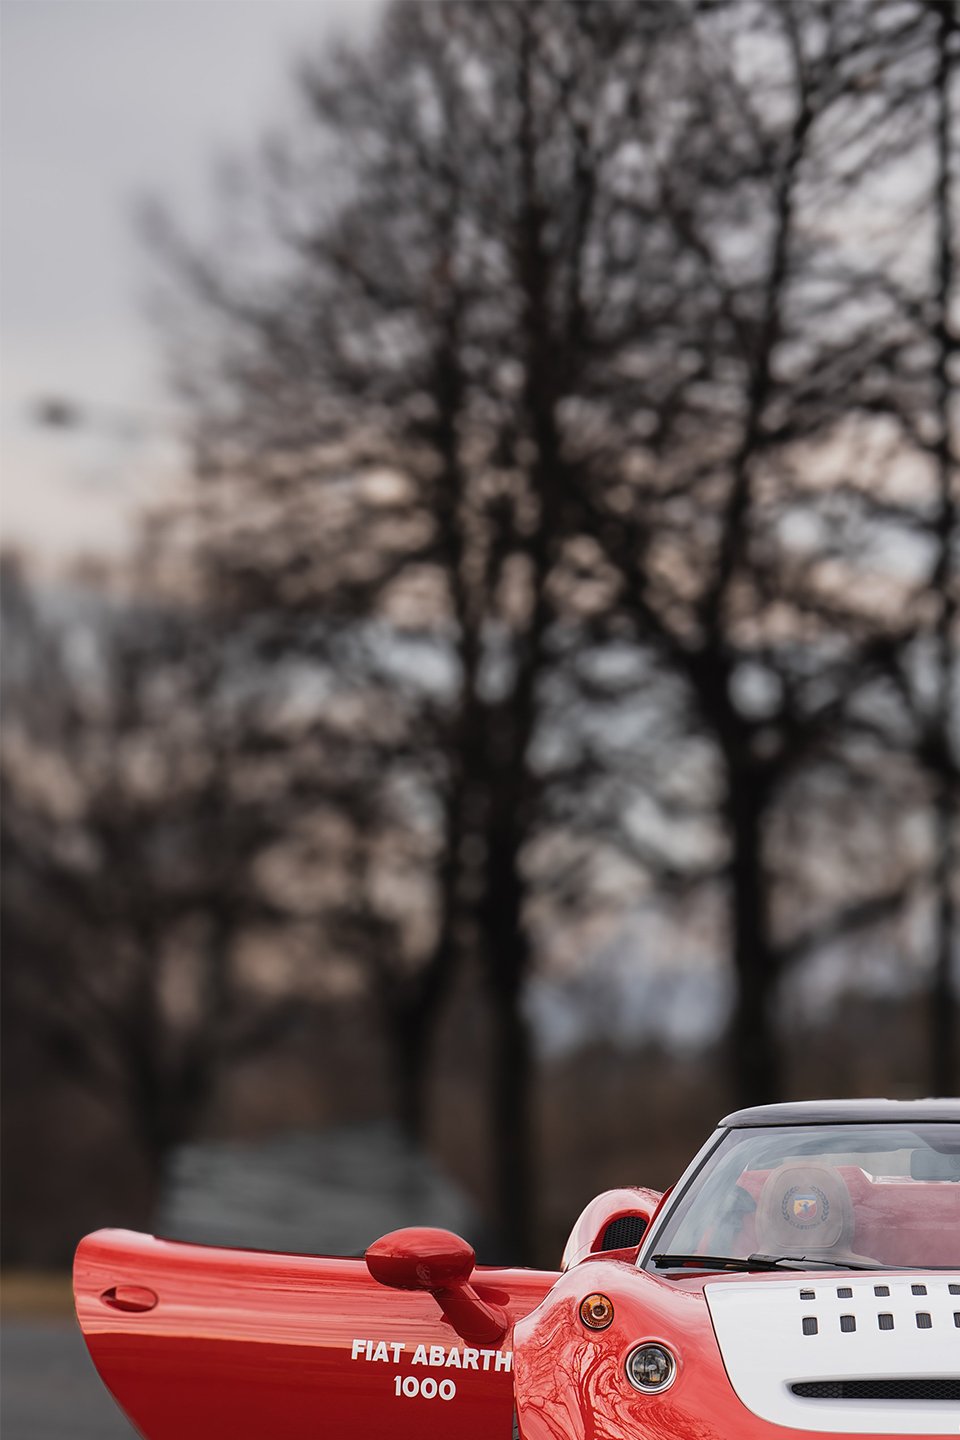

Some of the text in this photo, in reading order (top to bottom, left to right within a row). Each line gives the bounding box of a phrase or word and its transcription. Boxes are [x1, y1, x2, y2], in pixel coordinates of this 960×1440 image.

[351, 1339, 513, 1372] FIAT ABARTH
[394, 1375, 456, 1400] 1000
